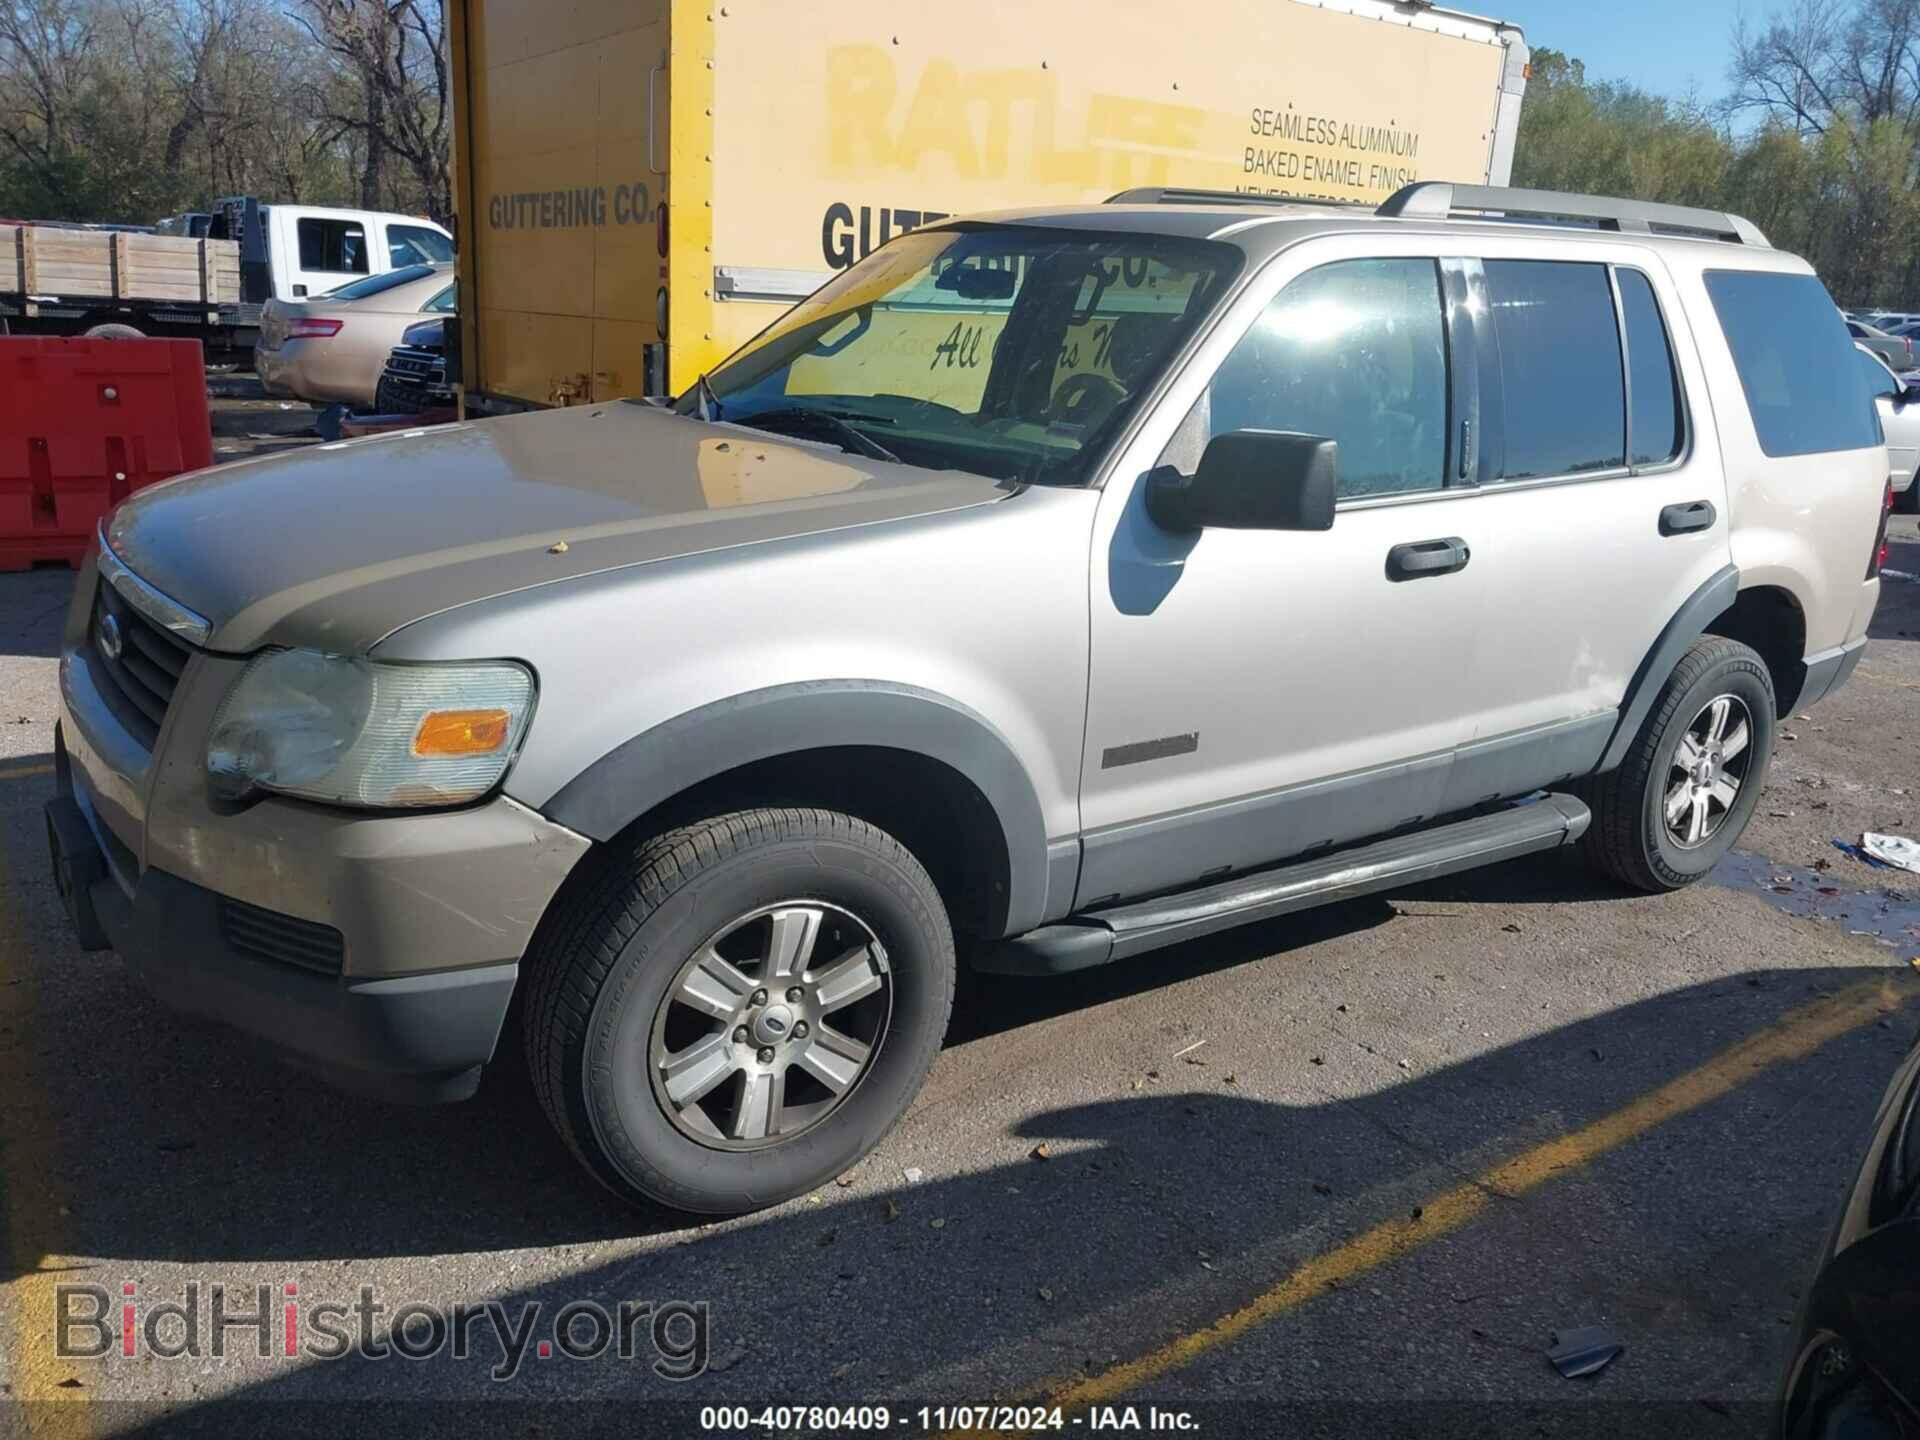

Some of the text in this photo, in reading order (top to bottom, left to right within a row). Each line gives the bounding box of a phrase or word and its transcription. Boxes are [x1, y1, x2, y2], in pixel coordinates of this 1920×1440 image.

[1250, 108, 1419, 159] SEAMLESS ALUMINUM
[1243, 147, 1417, 191] BAKED ENAMEL FINISH
[488, 181, 656, 231] GUTTERING CO.
[929, 321, 983, 370] All
